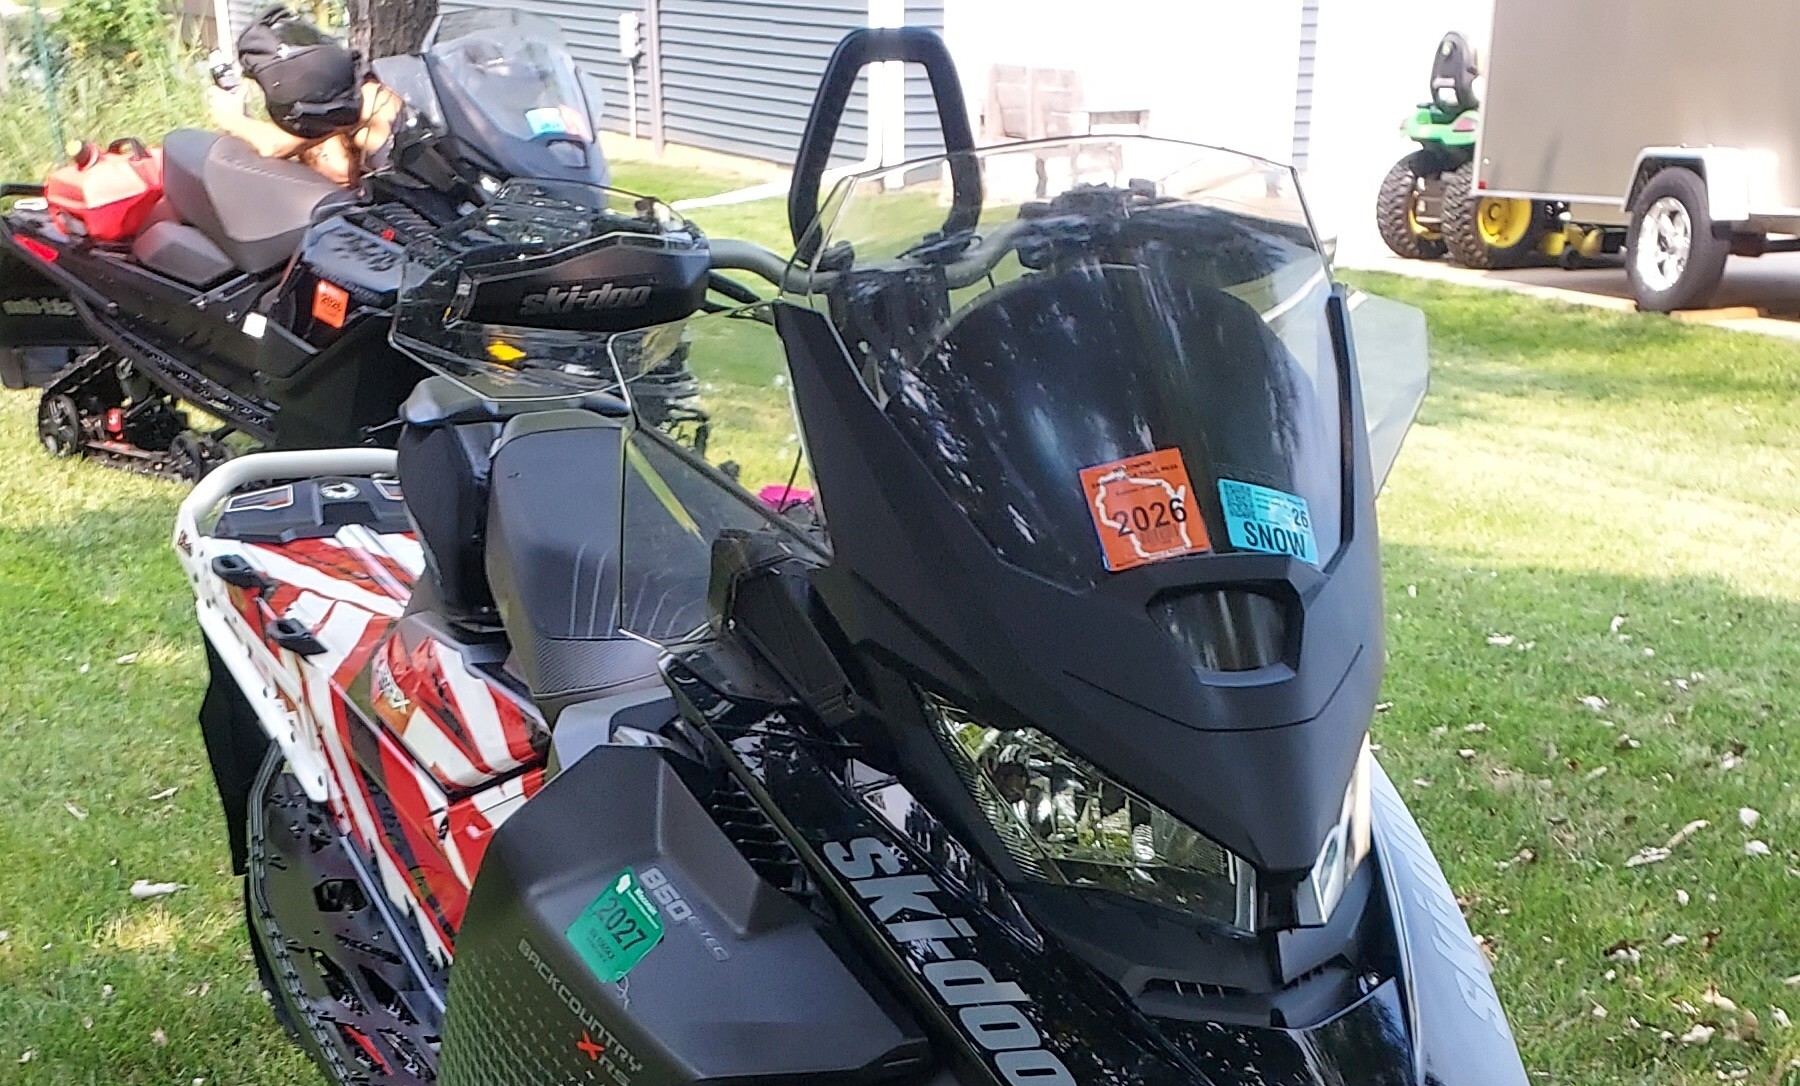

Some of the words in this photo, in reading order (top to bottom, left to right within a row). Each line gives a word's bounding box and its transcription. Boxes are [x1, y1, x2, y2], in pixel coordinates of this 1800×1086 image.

[1113, 498, 1187, 538] 2026
[1244, 522, 1306, 557] SNOW
[1291, 508, 1309, 528] 26
[639, 867, 693, 922] 850
[596, 897, 647, 950] 2027
[518, 938, 643, 1072] BACKCOUNTRY
